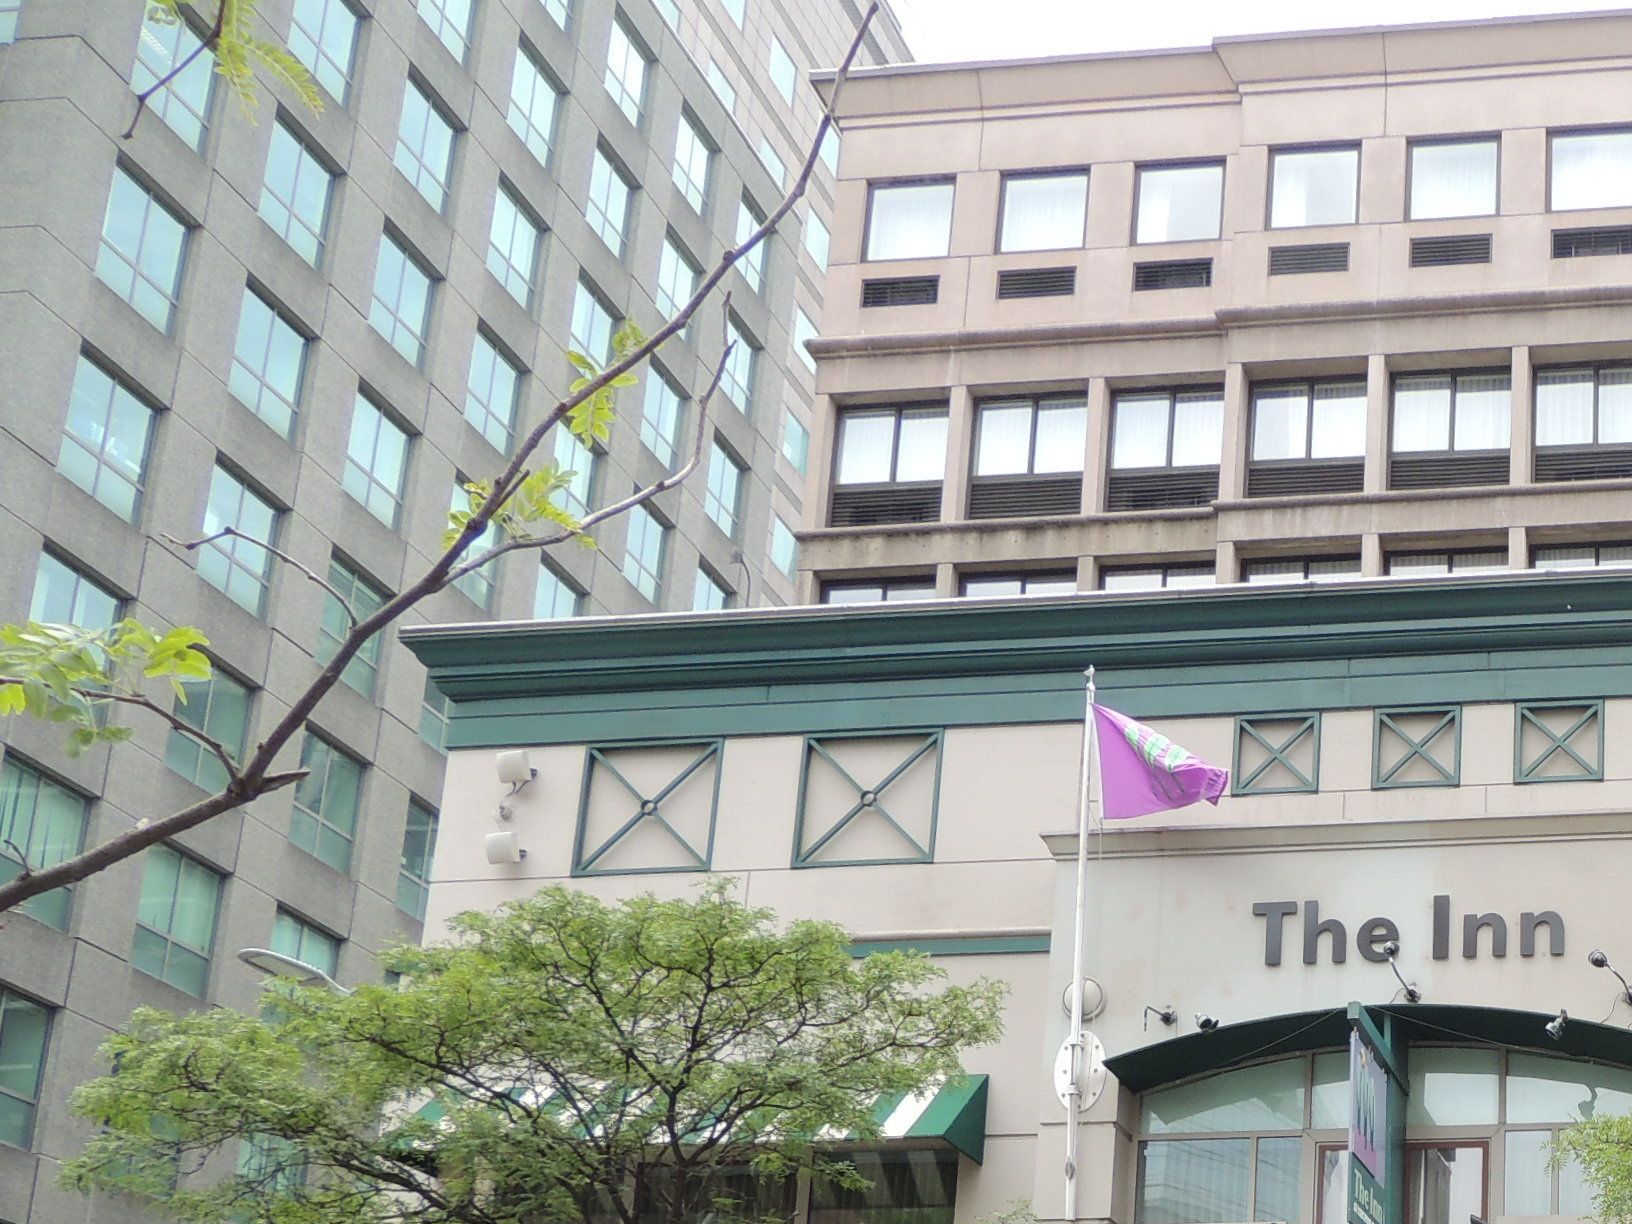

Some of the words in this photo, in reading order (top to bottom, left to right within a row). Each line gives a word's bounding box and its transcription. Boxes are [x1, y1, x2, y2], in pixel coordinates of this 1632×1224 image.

[1252, 899, 1400, 967] The
[1432, 894, 1566, 960] Inn
[1354, 1167, 1369, 1211] The
